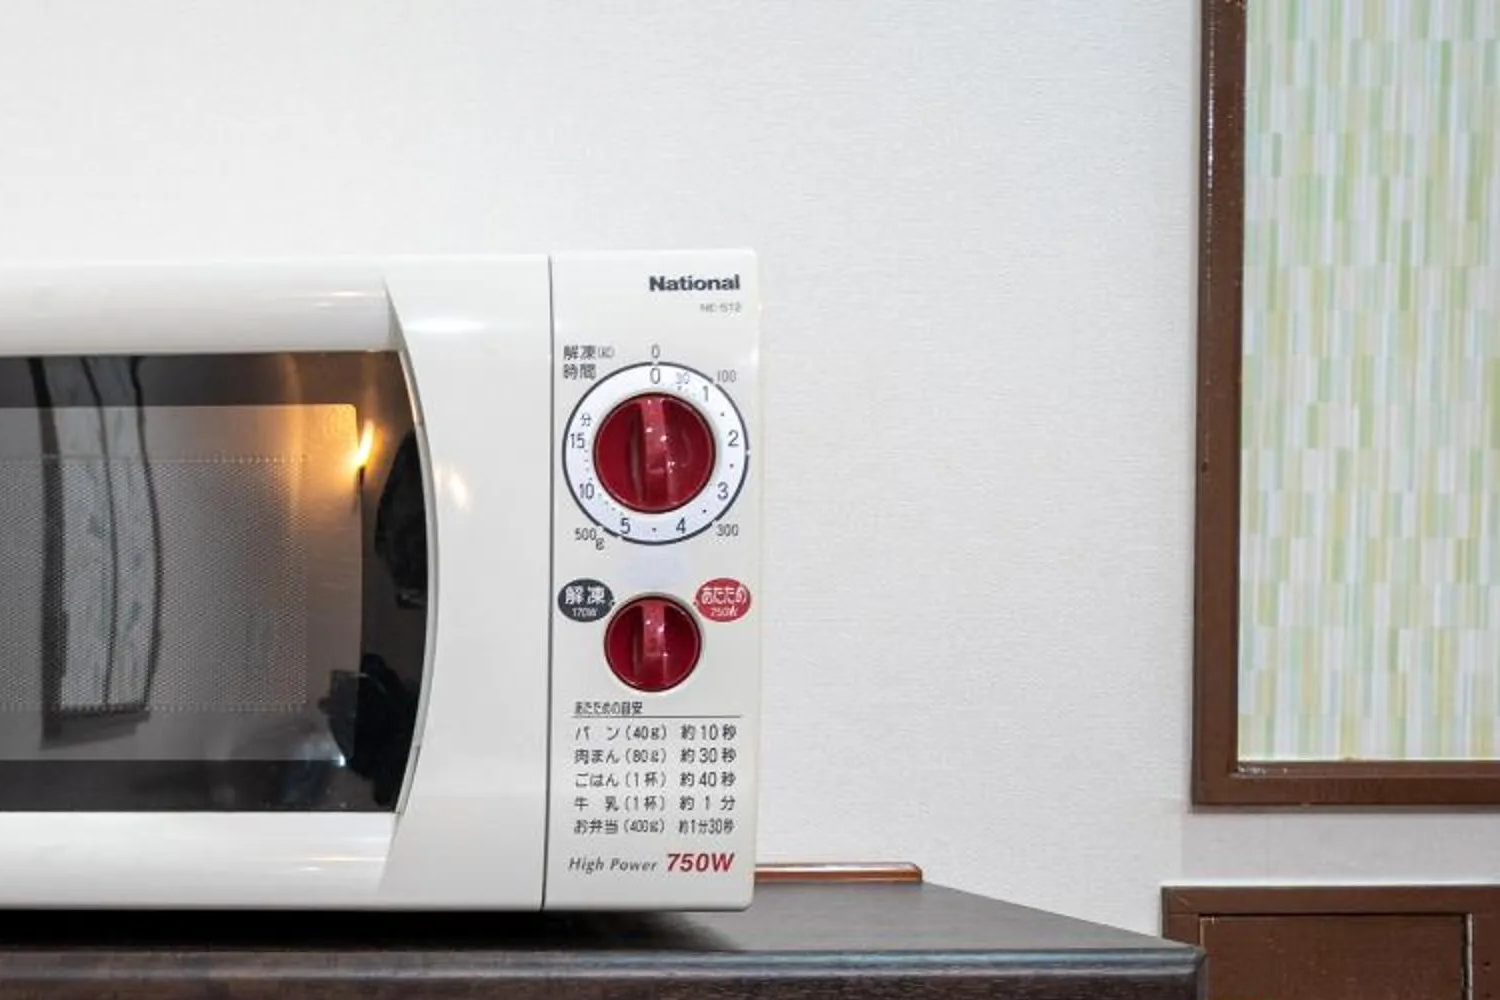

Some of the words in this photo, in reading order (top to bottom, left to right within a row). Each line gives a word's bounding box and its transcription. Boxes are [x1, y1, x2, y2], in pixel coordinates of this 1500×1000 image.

[649, 274, 741, 292] National
[651, 344, 660, 359] 0
[563, 364, 597, 380] 時間
[650, 368, 661, 384] 0
[717, 370, 737, 383] 100
[702, 386, 709, 401] 1
[580, 413, 592, 427] 分
[570, 433, 585, 449] 15
[727, 430, 740, 447] 2
[579, 483, 595, 500] 10
[717, 482, 729, 500] 3
[619, 518, 631, 534] 5
[675, 517, 687, 534] 4
[716, 523, 739, 537] 300
[564, 585, 606, 605] 解凍
[710, 606, 738, 617] 750W
[568, 857, 605, 875] High
[610, 857, 658, 872] Power
[666, 852, 736, 872] 750W
